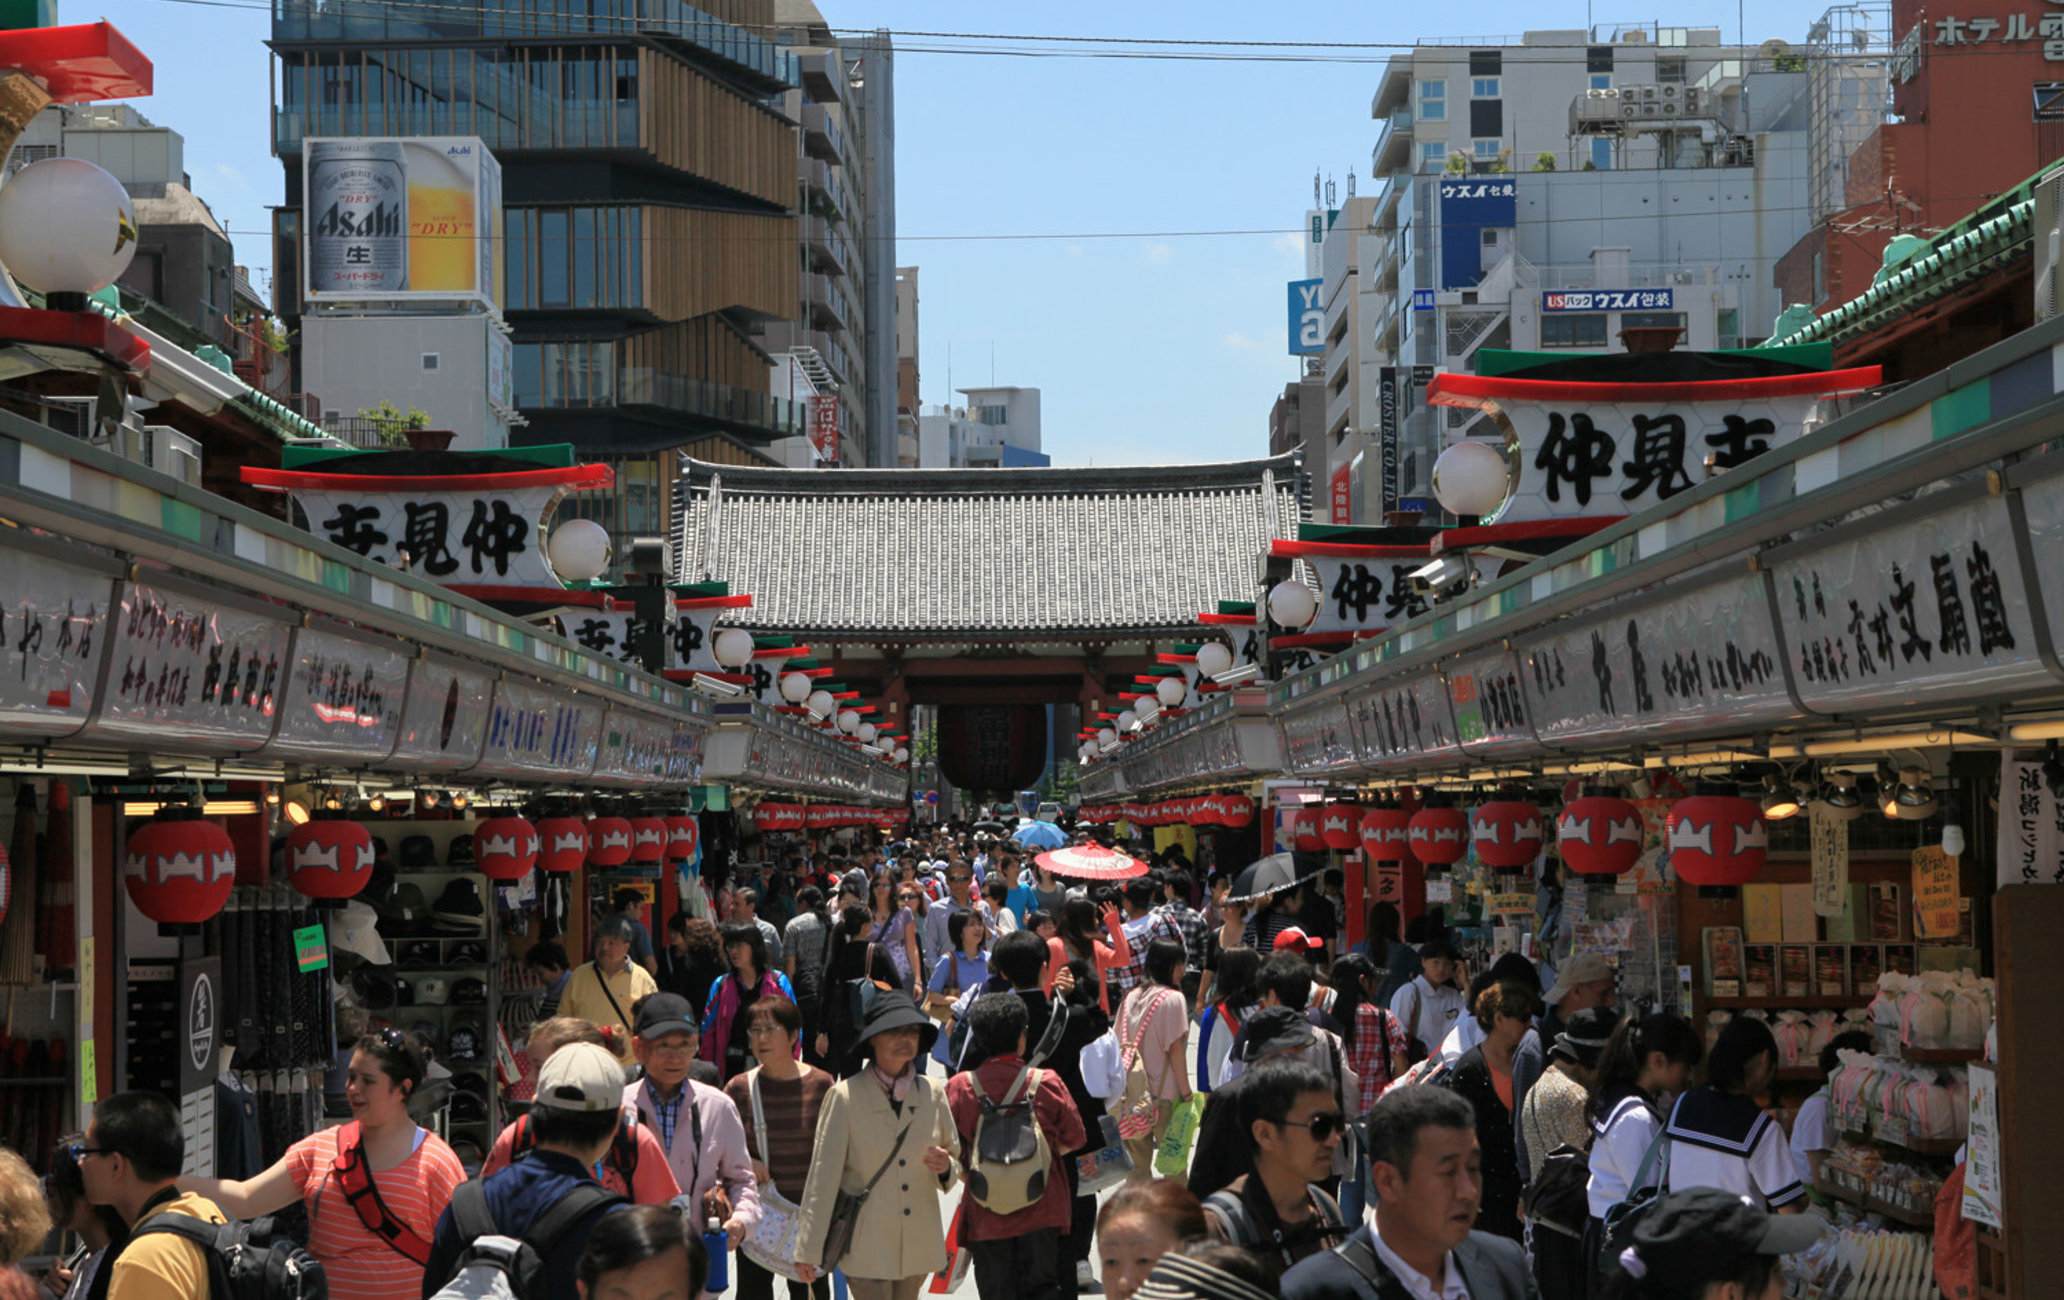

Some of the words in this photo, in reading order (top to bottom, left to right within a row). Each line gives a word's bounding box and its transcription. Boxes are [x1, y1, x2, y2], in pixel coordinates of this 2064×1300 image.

[447, 146, 472, 155] Asahi
[316, 200, 399, 238] Asahi
[346, 245, 371, 264] 生
[1382, 380, 1395, 443] CROSTER
